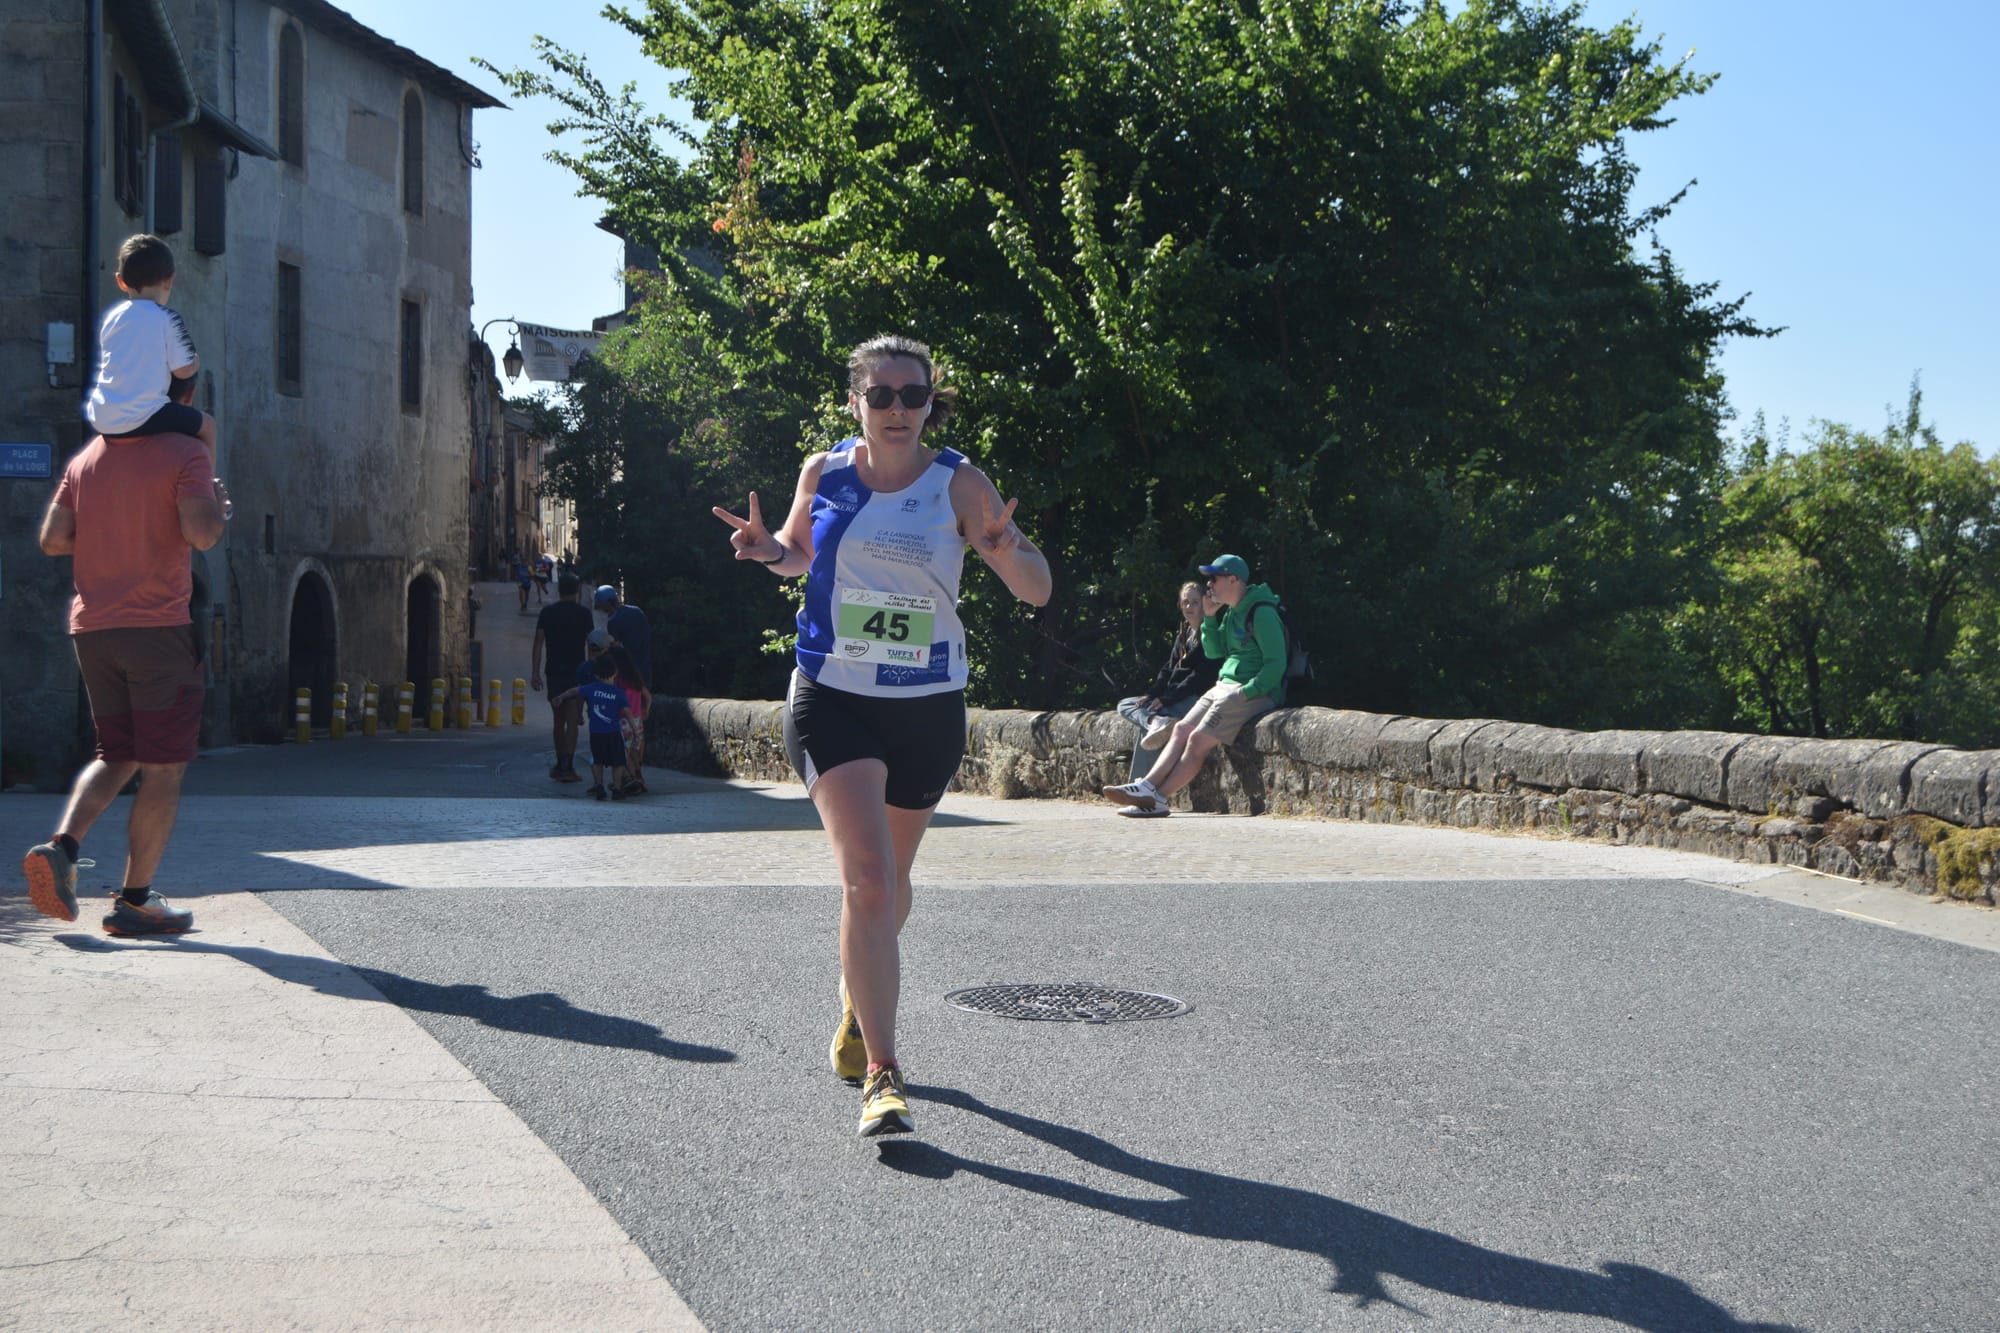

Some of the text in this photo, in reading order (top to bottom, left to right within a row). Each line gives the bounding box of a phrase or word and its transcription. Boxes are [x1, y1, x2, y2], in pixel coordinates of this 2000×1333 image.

[523, 326, 577, 338] MAISON
[12, 450, 39, 458] PLACE
[26, 463, 48, 471] LOGE
[863, 610, 909, 641] 45
[594, 690, 616, 700] ETHAN
